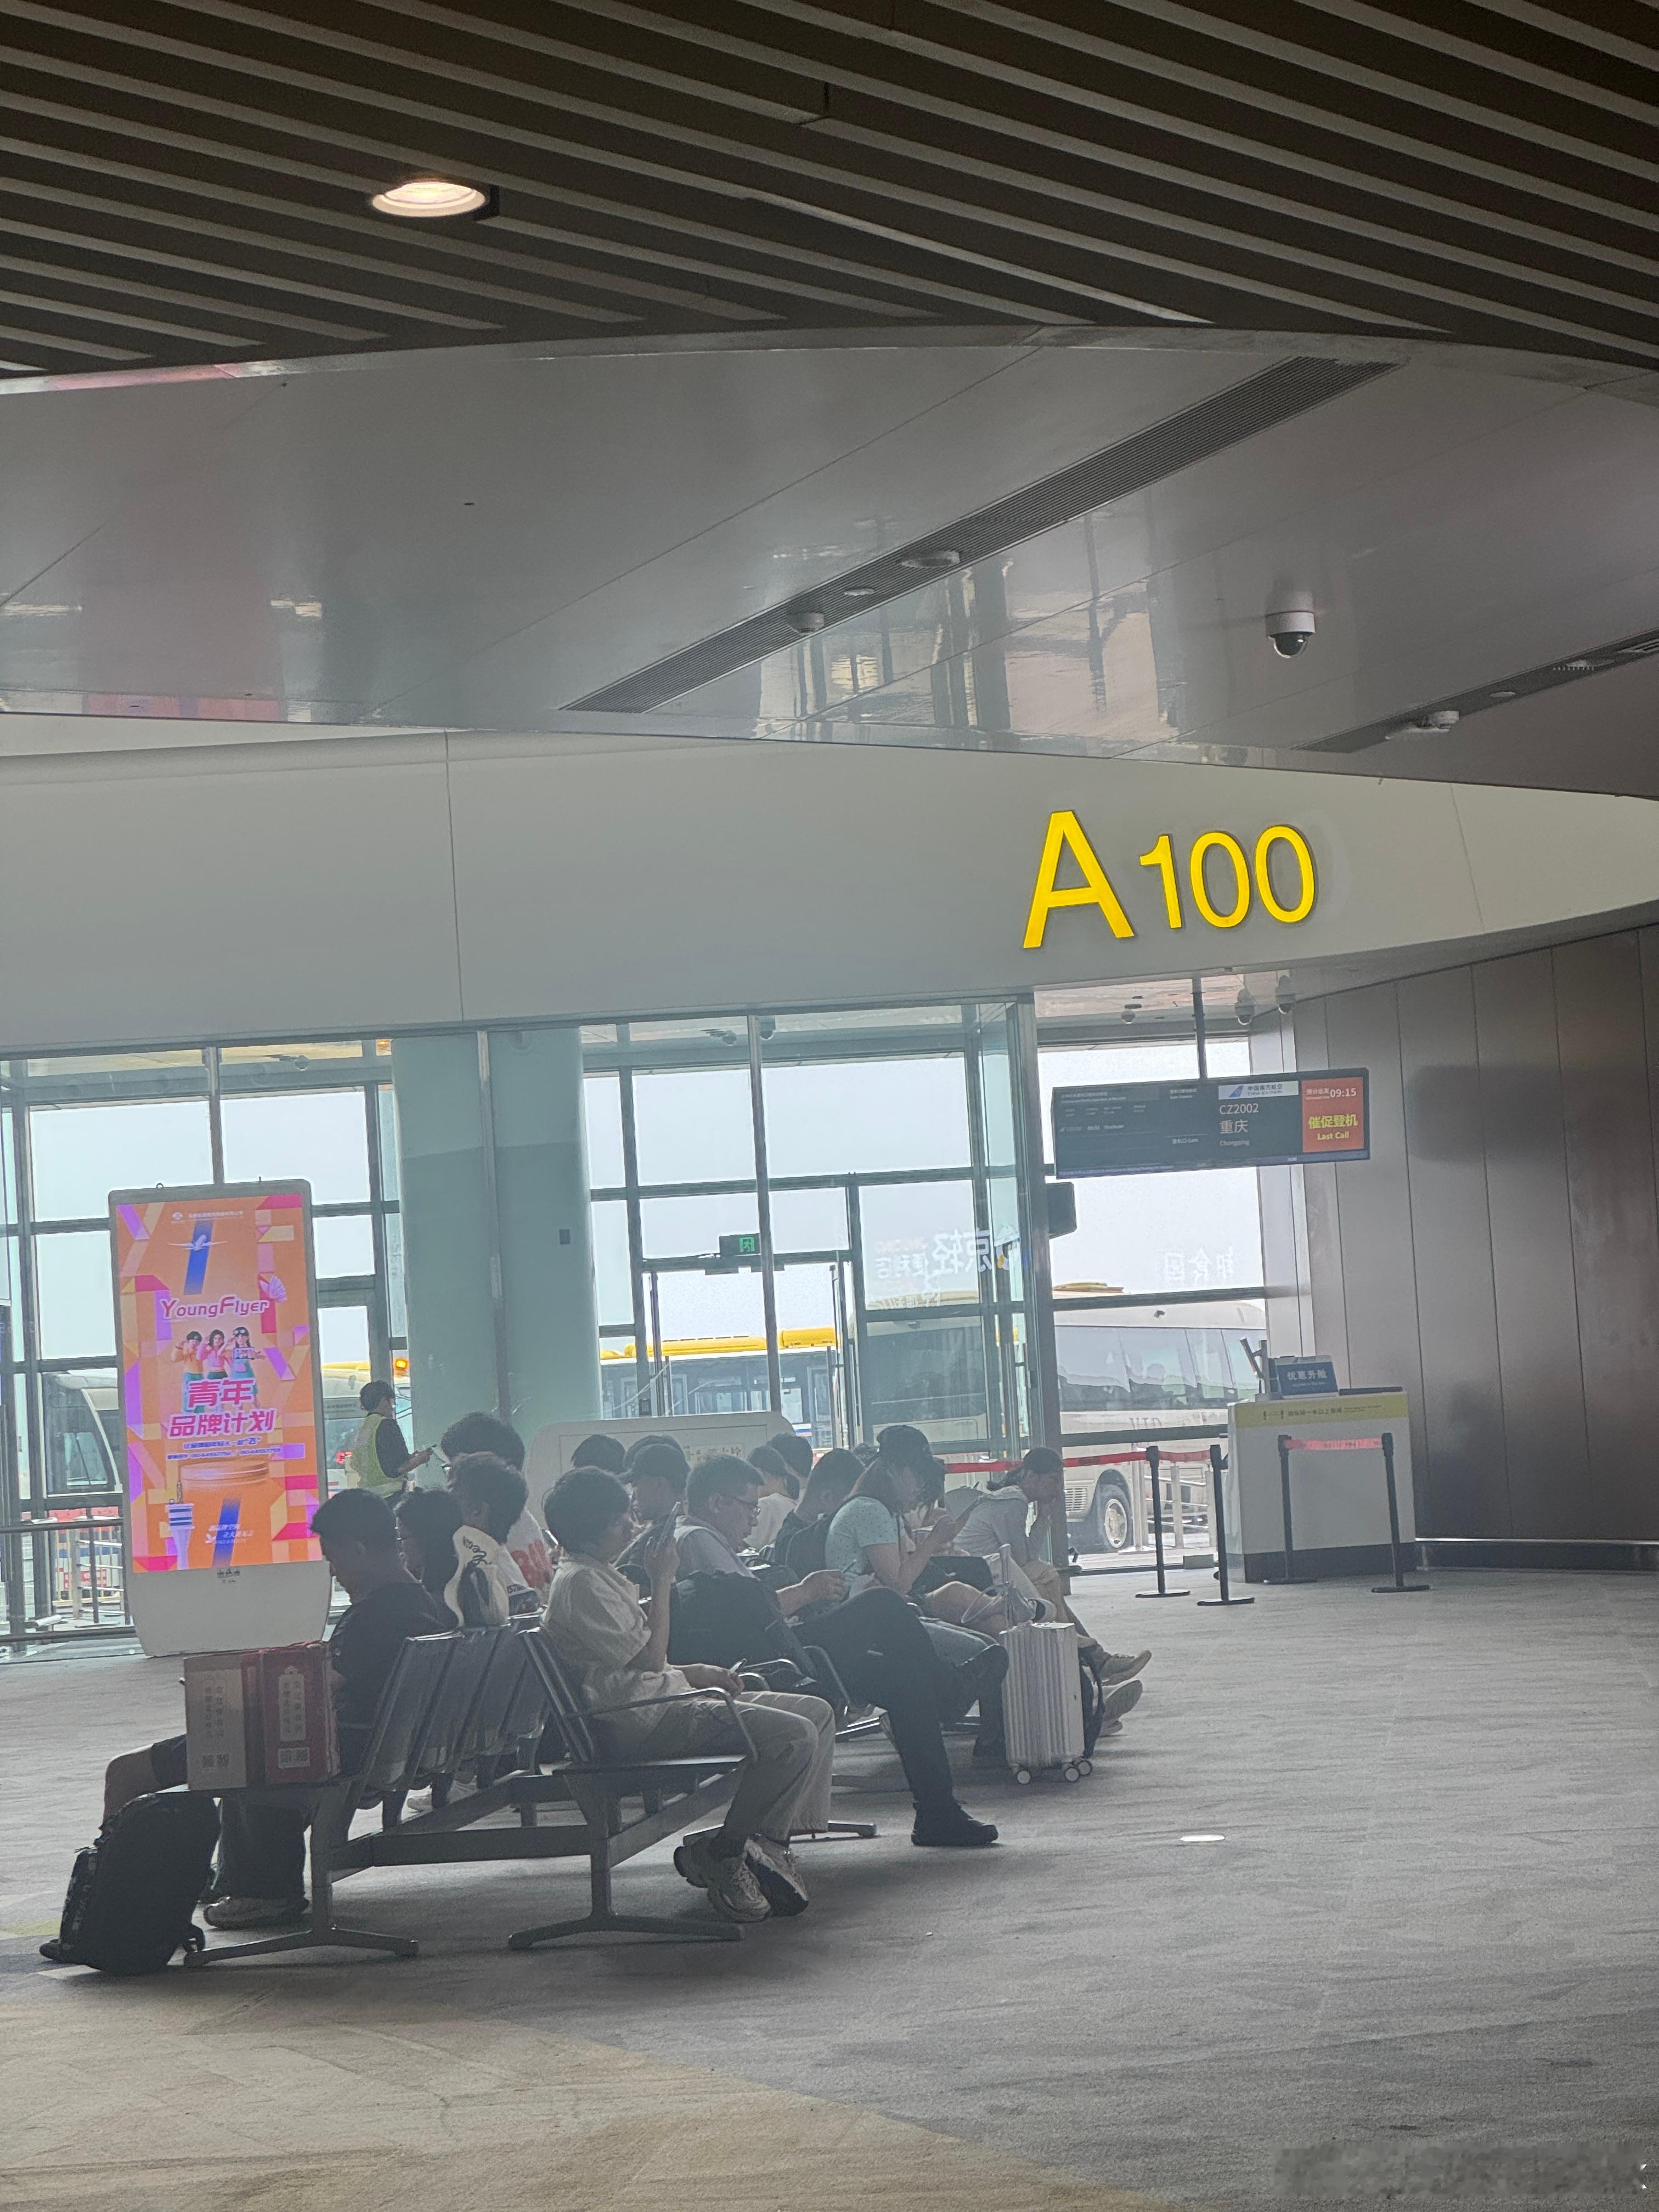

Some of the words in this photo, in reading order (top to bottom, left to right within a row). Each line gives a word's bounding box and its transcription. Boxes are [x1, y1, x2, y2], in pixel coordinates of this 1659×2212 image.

[1330, 1088, 1357, 1098] 09:15
[1220, 1103, 1259, 1115] CZ2002
[1220, 1119, 1249, 1134] 重庆
[1308, 1114, 1358, 1130] 催促登机
[188, 1379, 254, 1408] 青年
[169, 1410, 275, 1437] 品牌计划
